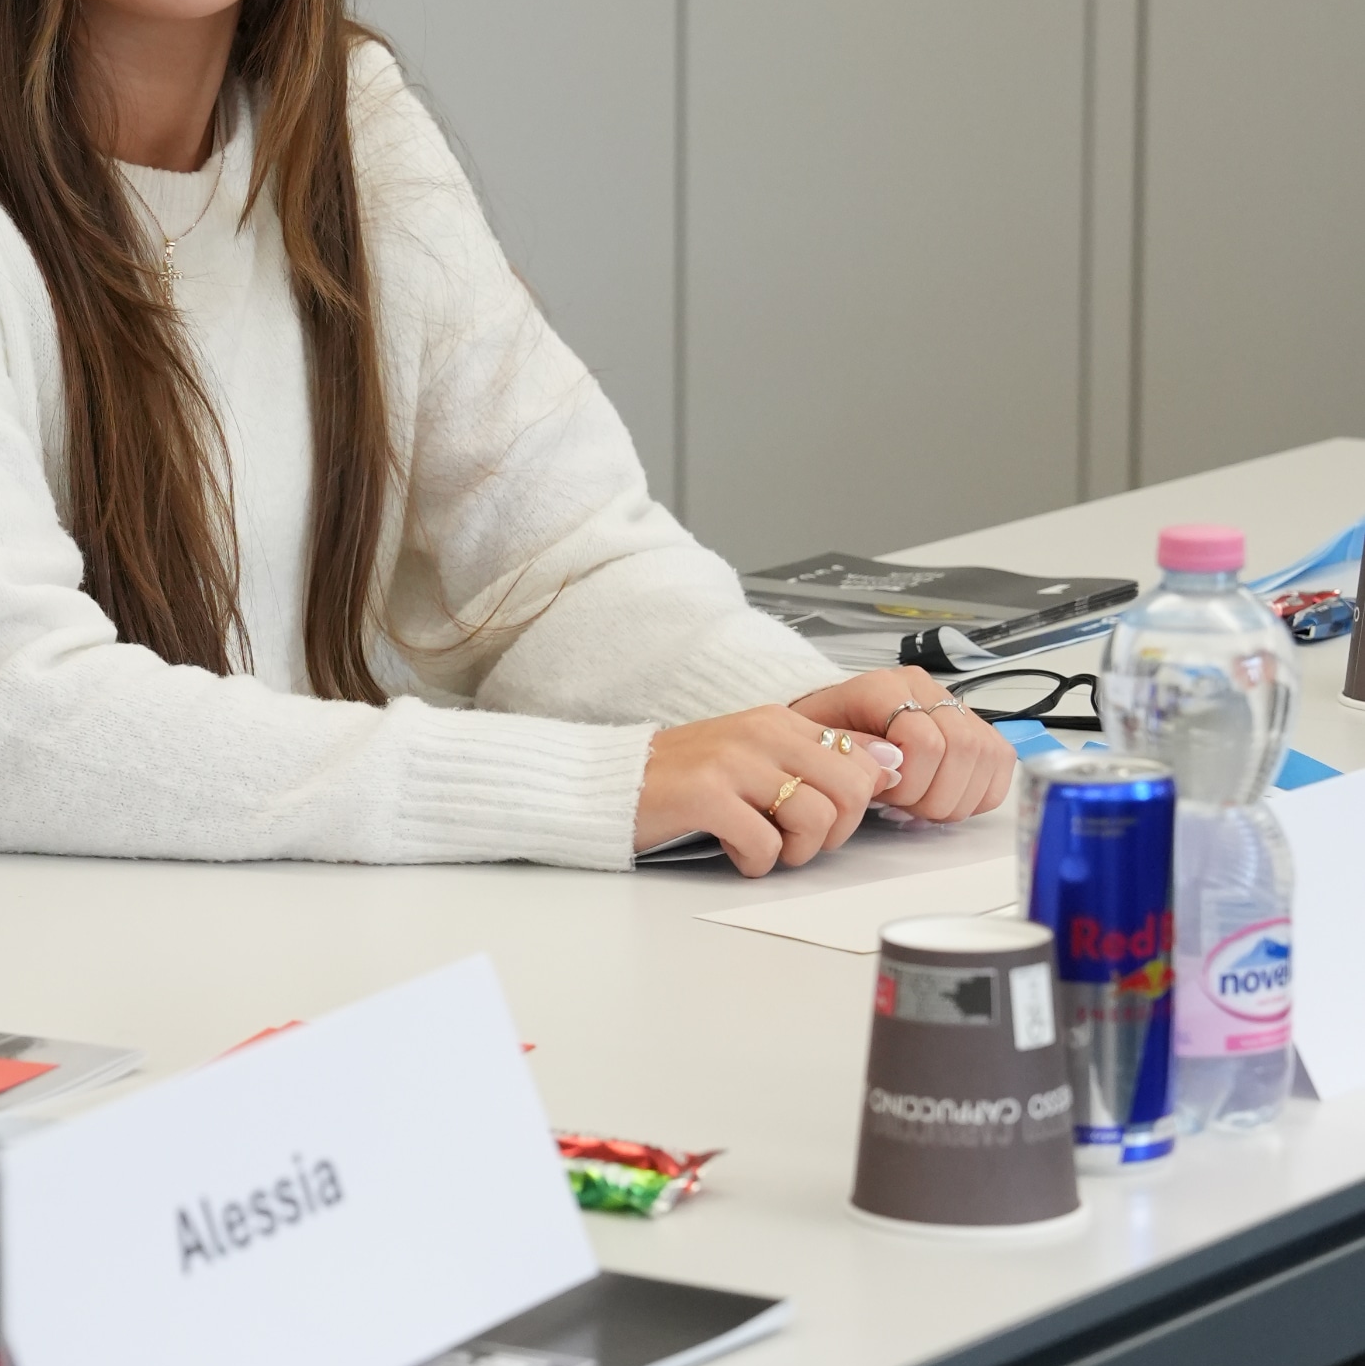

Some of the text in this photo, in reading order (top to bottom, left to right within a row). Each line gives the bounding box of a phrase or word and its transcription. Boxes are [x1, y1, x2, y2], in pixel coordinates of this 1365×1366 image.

[1071, 911, 1157, 960] Red
[1219, 962, 1291, 996] nove
[869, 1087, 1022, 1126] CAPPUCCINO
[176, 1151, 343, 1275] Alessia
